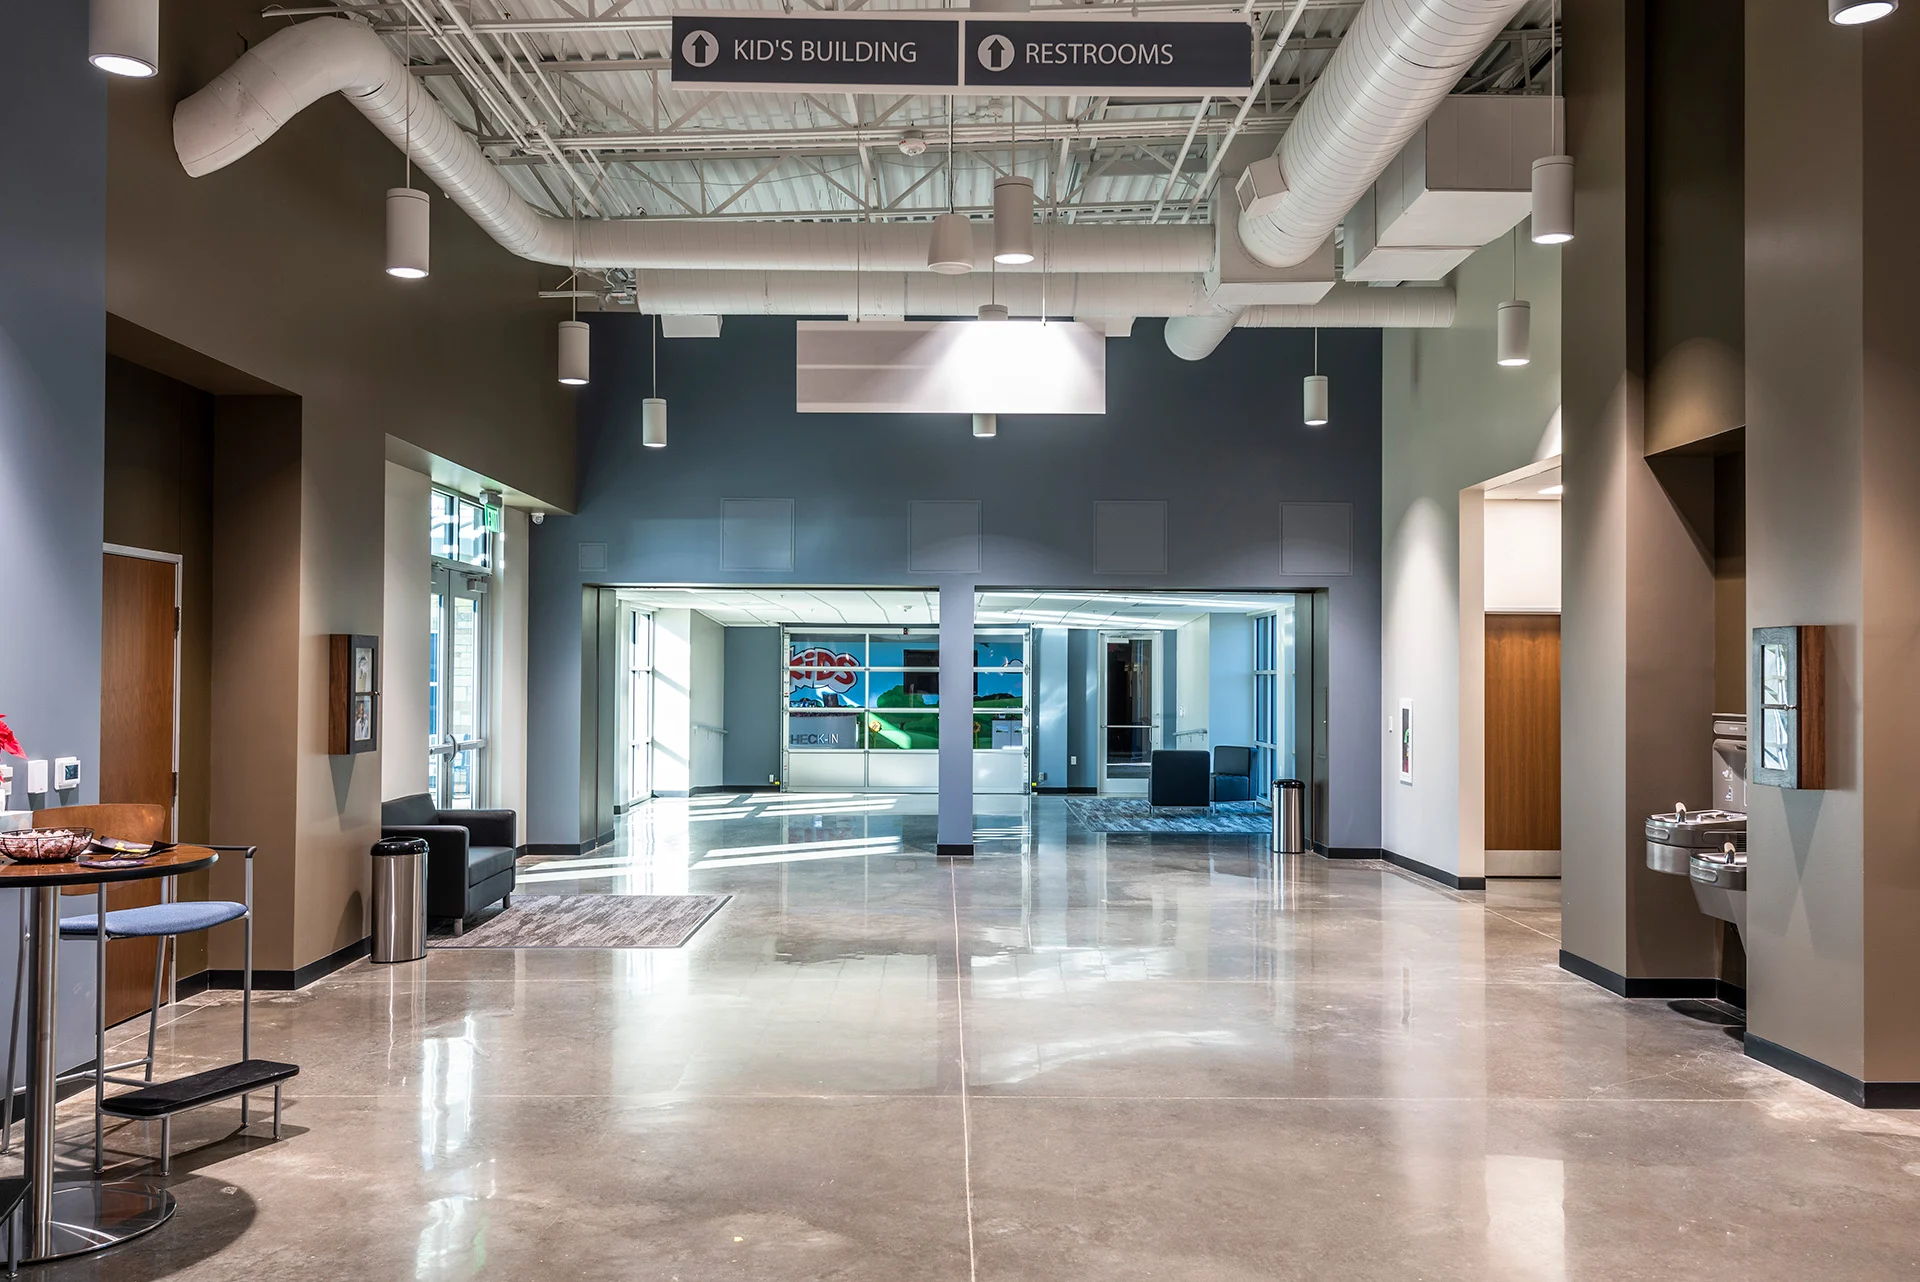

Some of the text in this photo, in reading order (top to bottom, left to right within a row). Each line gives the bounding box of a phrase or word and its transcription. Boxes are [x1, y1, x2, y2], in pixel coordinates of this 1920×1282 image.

[734, 39, 917, 63] KID'S BUILDING
[1026, 43, 1174, 65] RESTROOMS
[790, 733, 839, 745] HECK-IN
